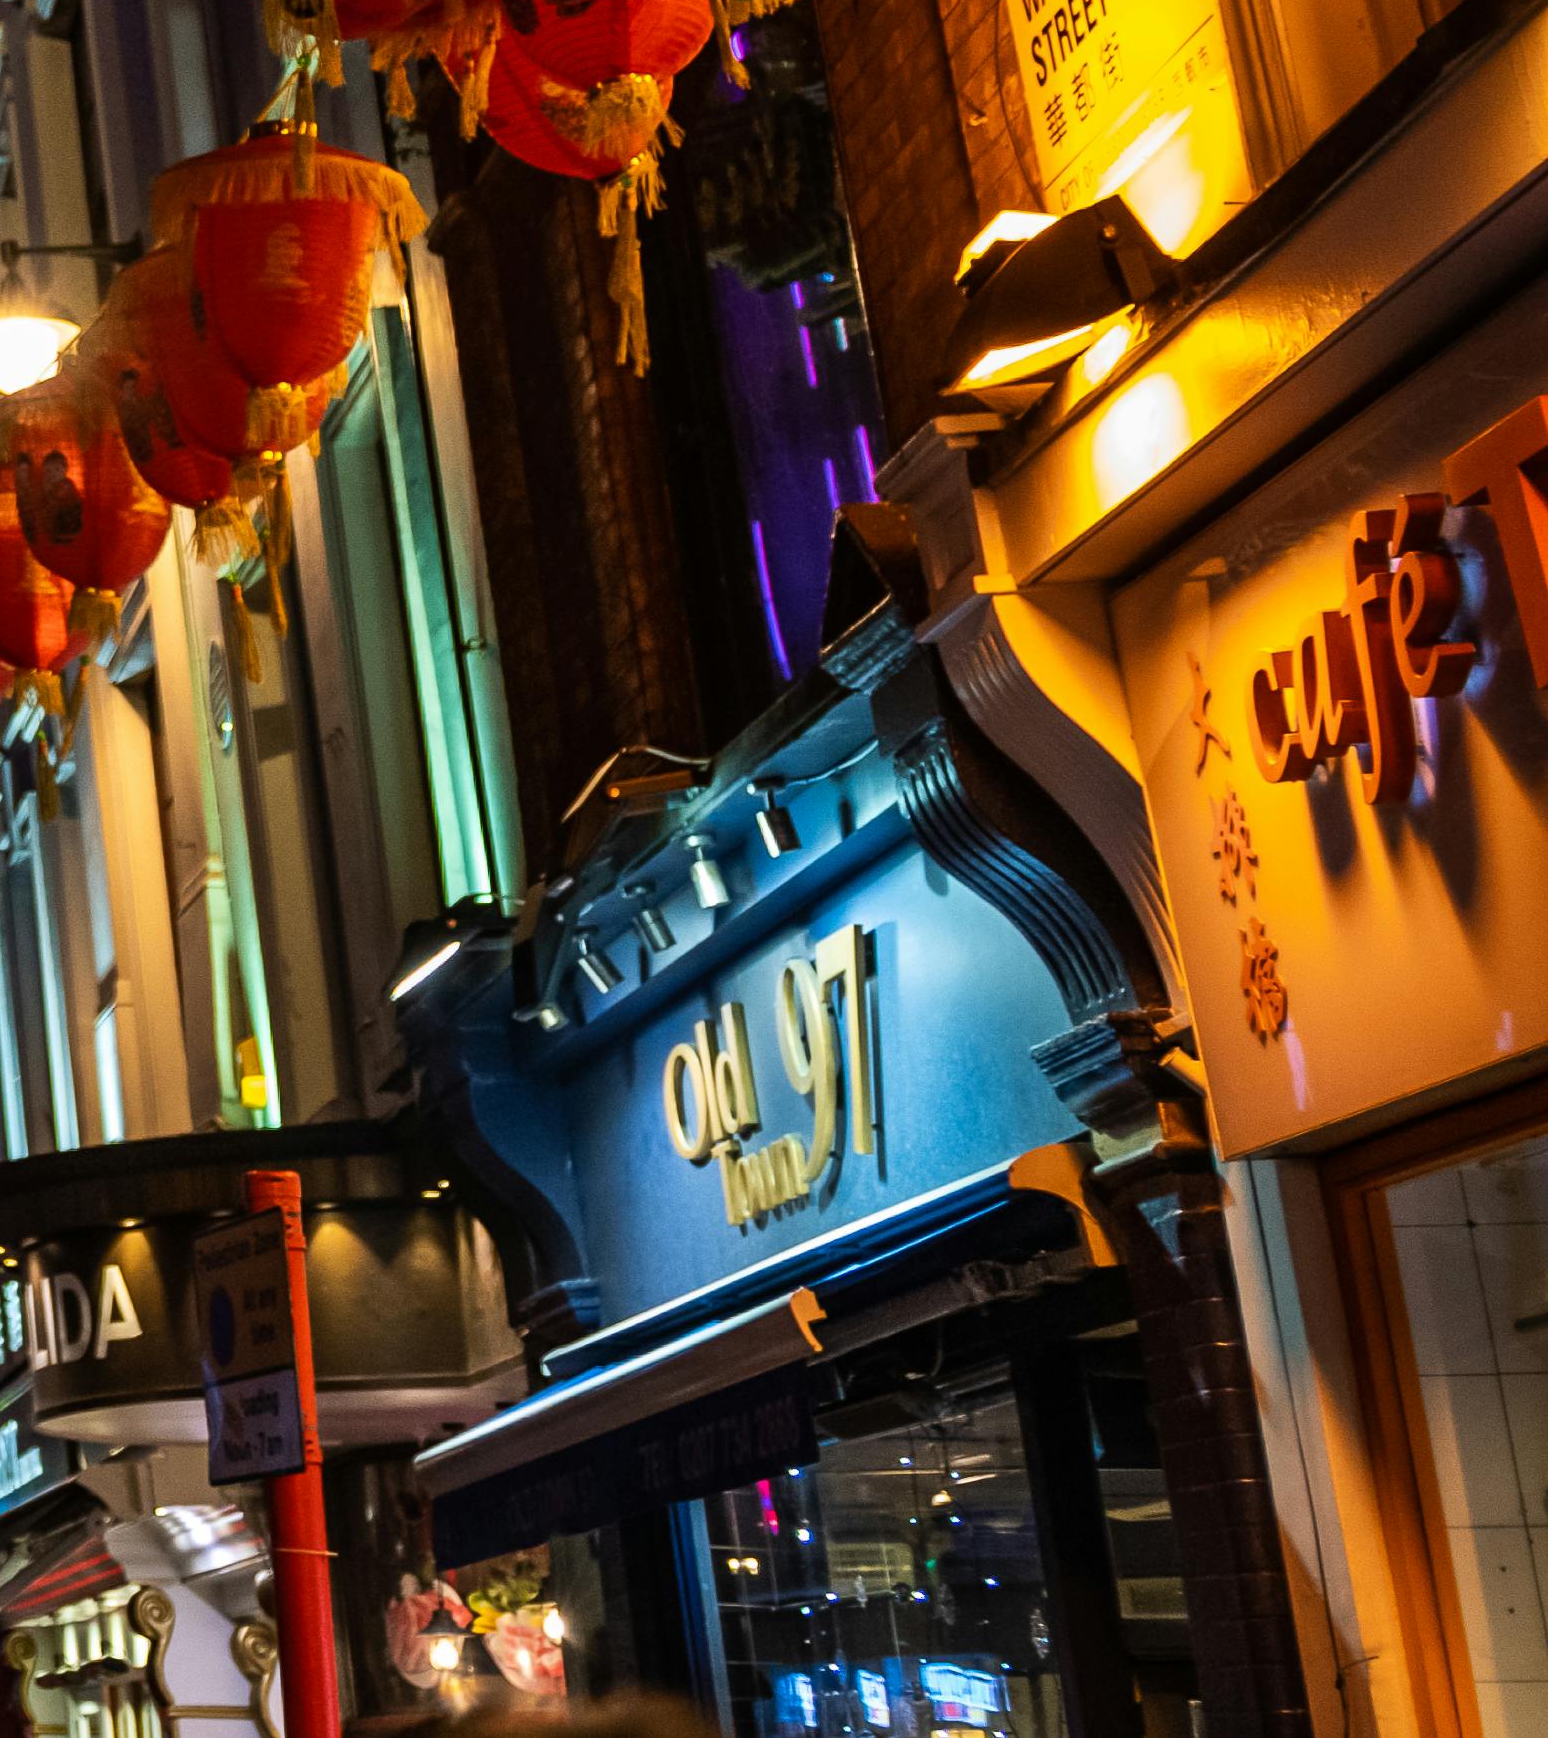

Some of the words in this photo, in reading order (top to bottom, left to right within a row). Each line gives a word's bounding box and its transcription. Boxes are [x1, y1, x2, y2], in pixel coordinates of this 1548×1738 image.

[1248, 493, 1477, 805] café
[663, 1001, 761, 1160] Old
[775, 923, 875, 1183] 97
